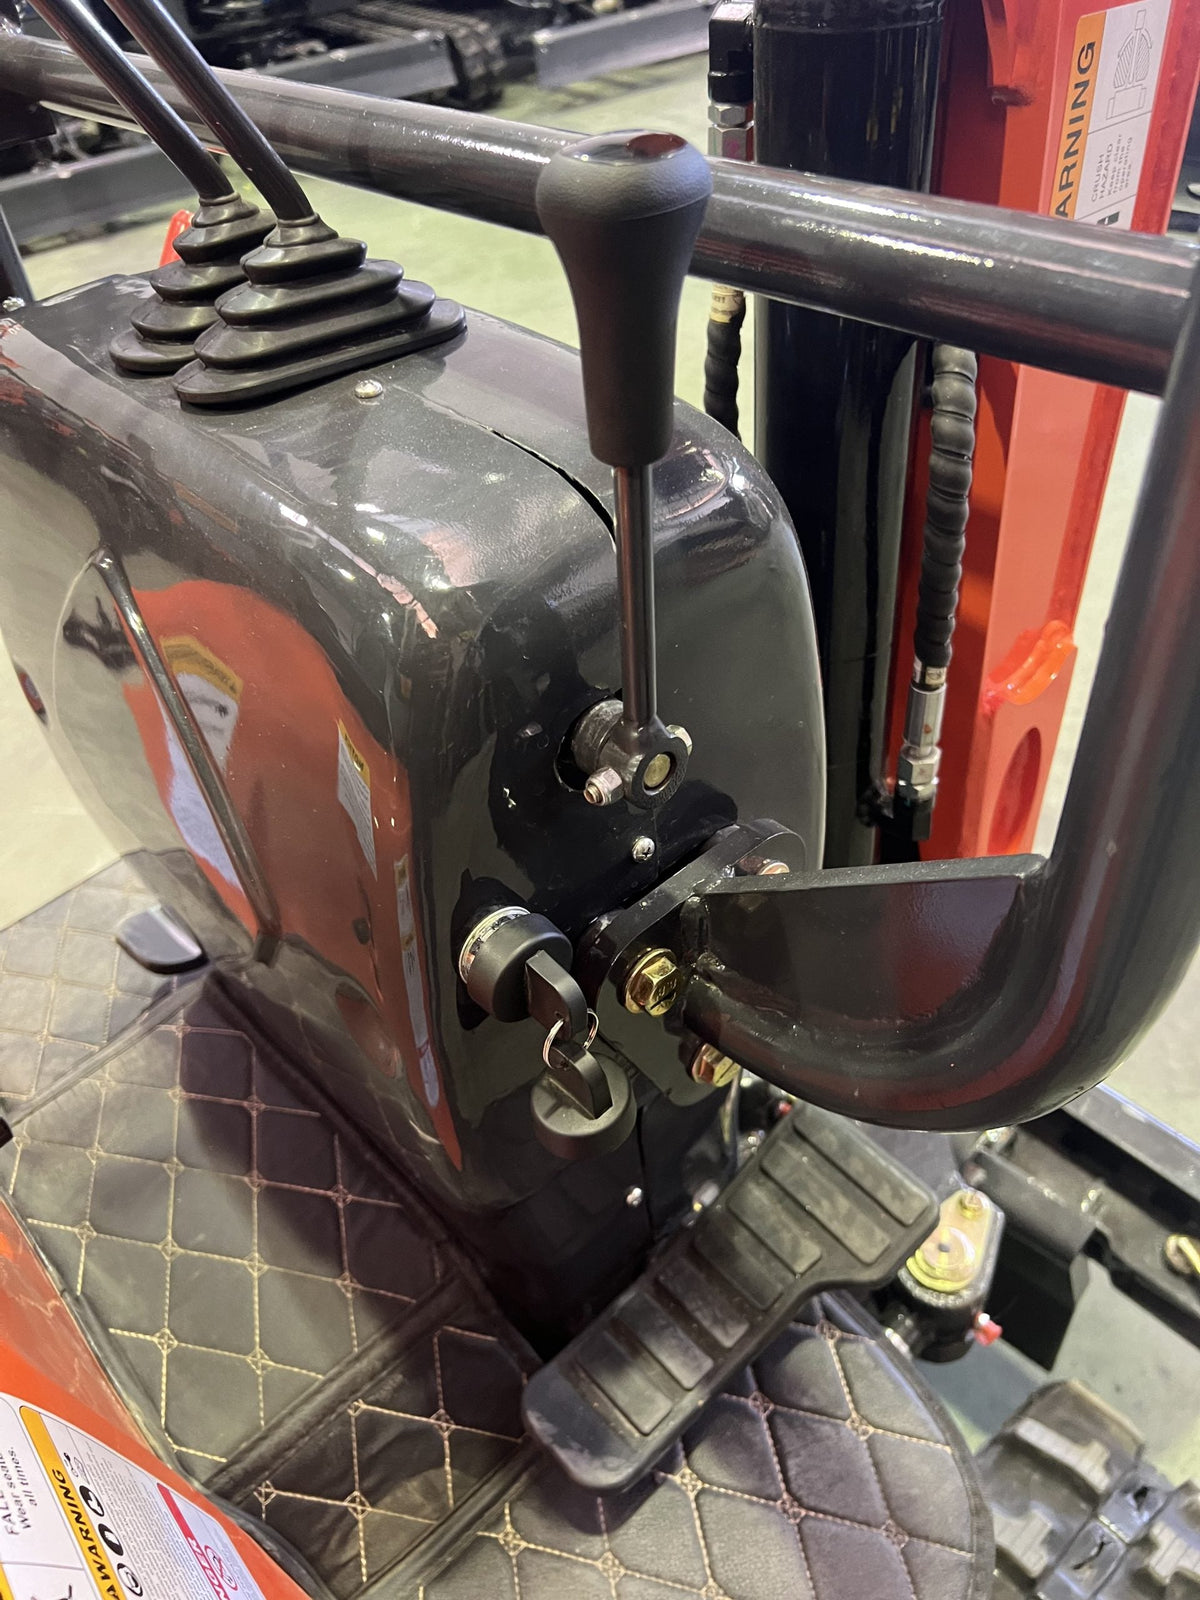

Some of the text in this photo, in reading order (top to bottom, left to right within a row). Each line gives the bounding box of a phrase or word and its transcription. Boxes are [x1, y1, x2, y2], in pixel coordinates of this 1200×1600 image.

[1054, 40, 1096, 219] ARNING
[1091, 153, 1105, 202] CRUSH
[1098, 143, 1114, 200] HAZARD
[8, 1446, 38, 1507] all times.
[11, 1492, 32, 1530] Wear
[52, 1468, 112, 1581] WARNING
[187, 1536, 228, 1600] NGER
